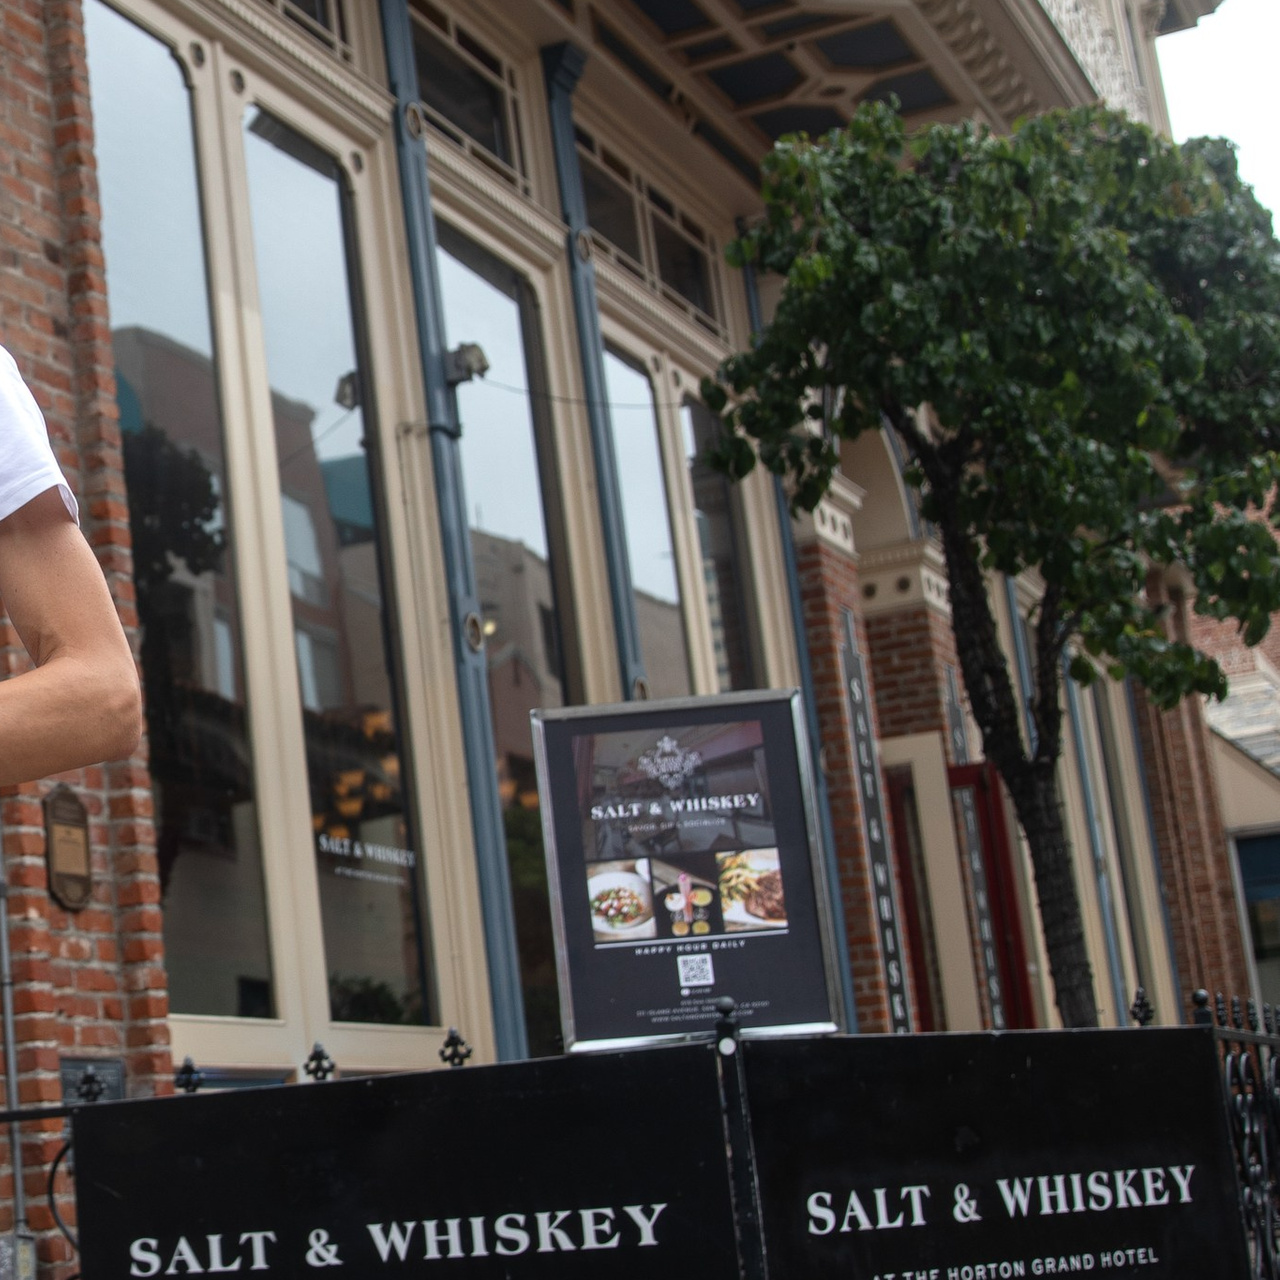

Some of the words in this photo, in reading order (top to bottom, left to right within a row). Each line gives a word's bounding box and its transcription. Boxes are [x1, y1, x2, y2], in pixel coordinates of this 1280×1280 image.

[591, 803, 642, 819] SALT
[649, 802, 662, 815] &
[670, 793, 759, 813] WHISKEY
[635, 945, 672, 956] HAPPY
[677, 942, 708, 952] HOUR
[712, 940, 746, 950] DAILY
[806, 1184, 931, 1235] SALT
[952, 1183, 982, 1222] &
[996, 1164, 1196, 1218] WHISKEY
[129, 1231, 277, 1277] SALT
[305, 1228, 342, 1267] &
[366, 1203, 667, 1262] WHISKEY
[1031, 1253, 1095, 1276] GRAND
[1101, 1247, 1159, 1269] HOTEL
